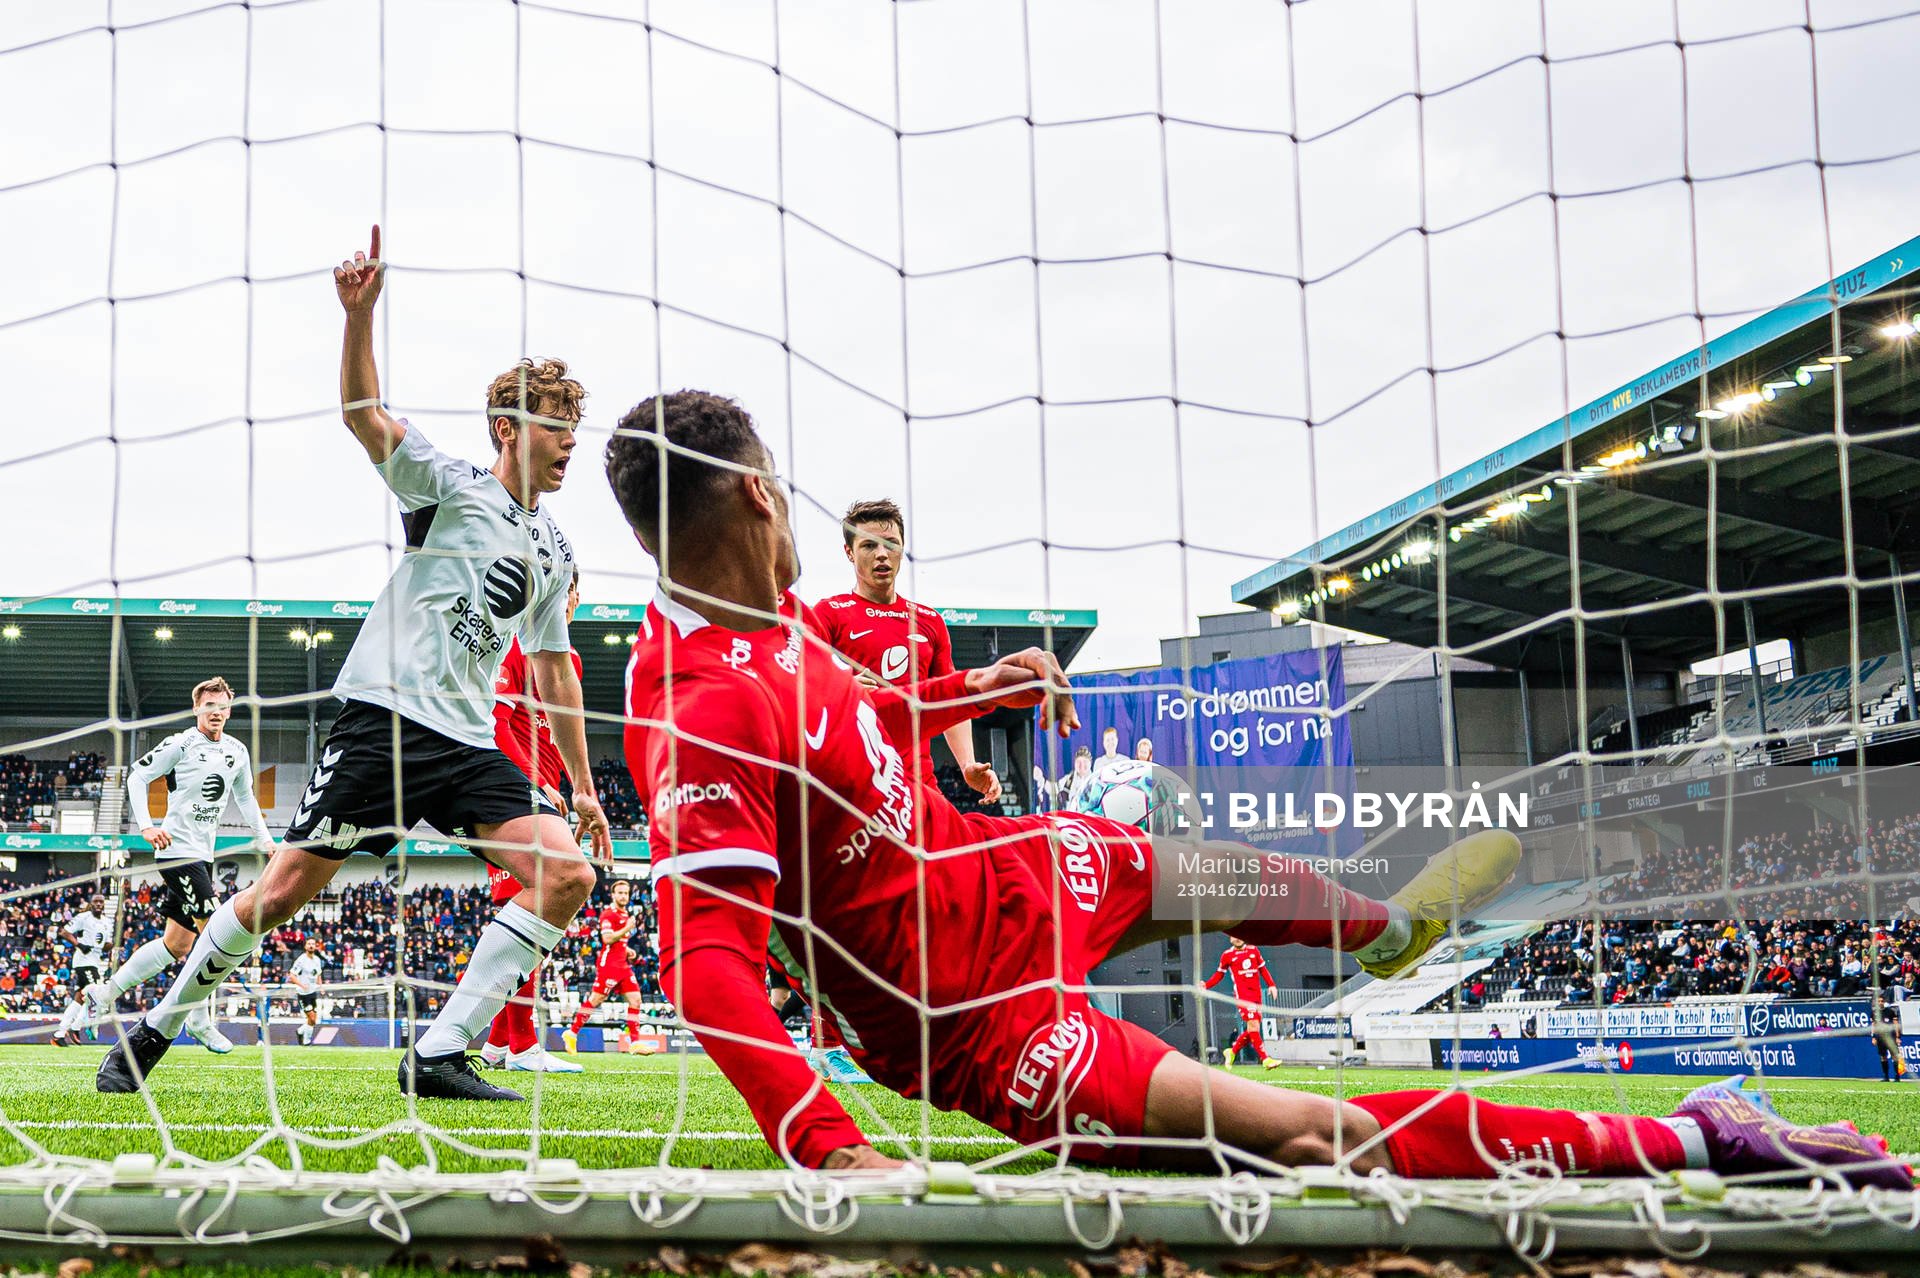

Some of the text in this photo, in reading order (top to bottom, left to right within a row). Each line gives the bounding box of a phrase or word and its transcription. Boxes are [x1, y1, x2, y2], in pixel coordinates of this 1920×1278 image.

[1590, 401, 1610, 421] DITT
[1612, 389, 1632, 410] NYE
[1484, 453, 1504, 475] FJUZ
[1390, 502, 1408, 521] FJUZ
[1157, 679, 1330, 721] For drømmen
[1210, 727, 1249, 757] og
[1256, 717, 1295, 747] for
[1811, 757, 1840, 776] FJUZ
[1753, 771, 1767, 787] IDÉ
[1687, 781, 1711, 798] FJUZ
[1627, 794, 1661, 811] STRATEGI
[1534, 814, 1554, 826] PROFIL
[1486, 1050, 1497, 1067] og
[1510, 1045, 1519, 1063] nå
[1674, 1044, 1796, 1071] For drømmen og for nå
